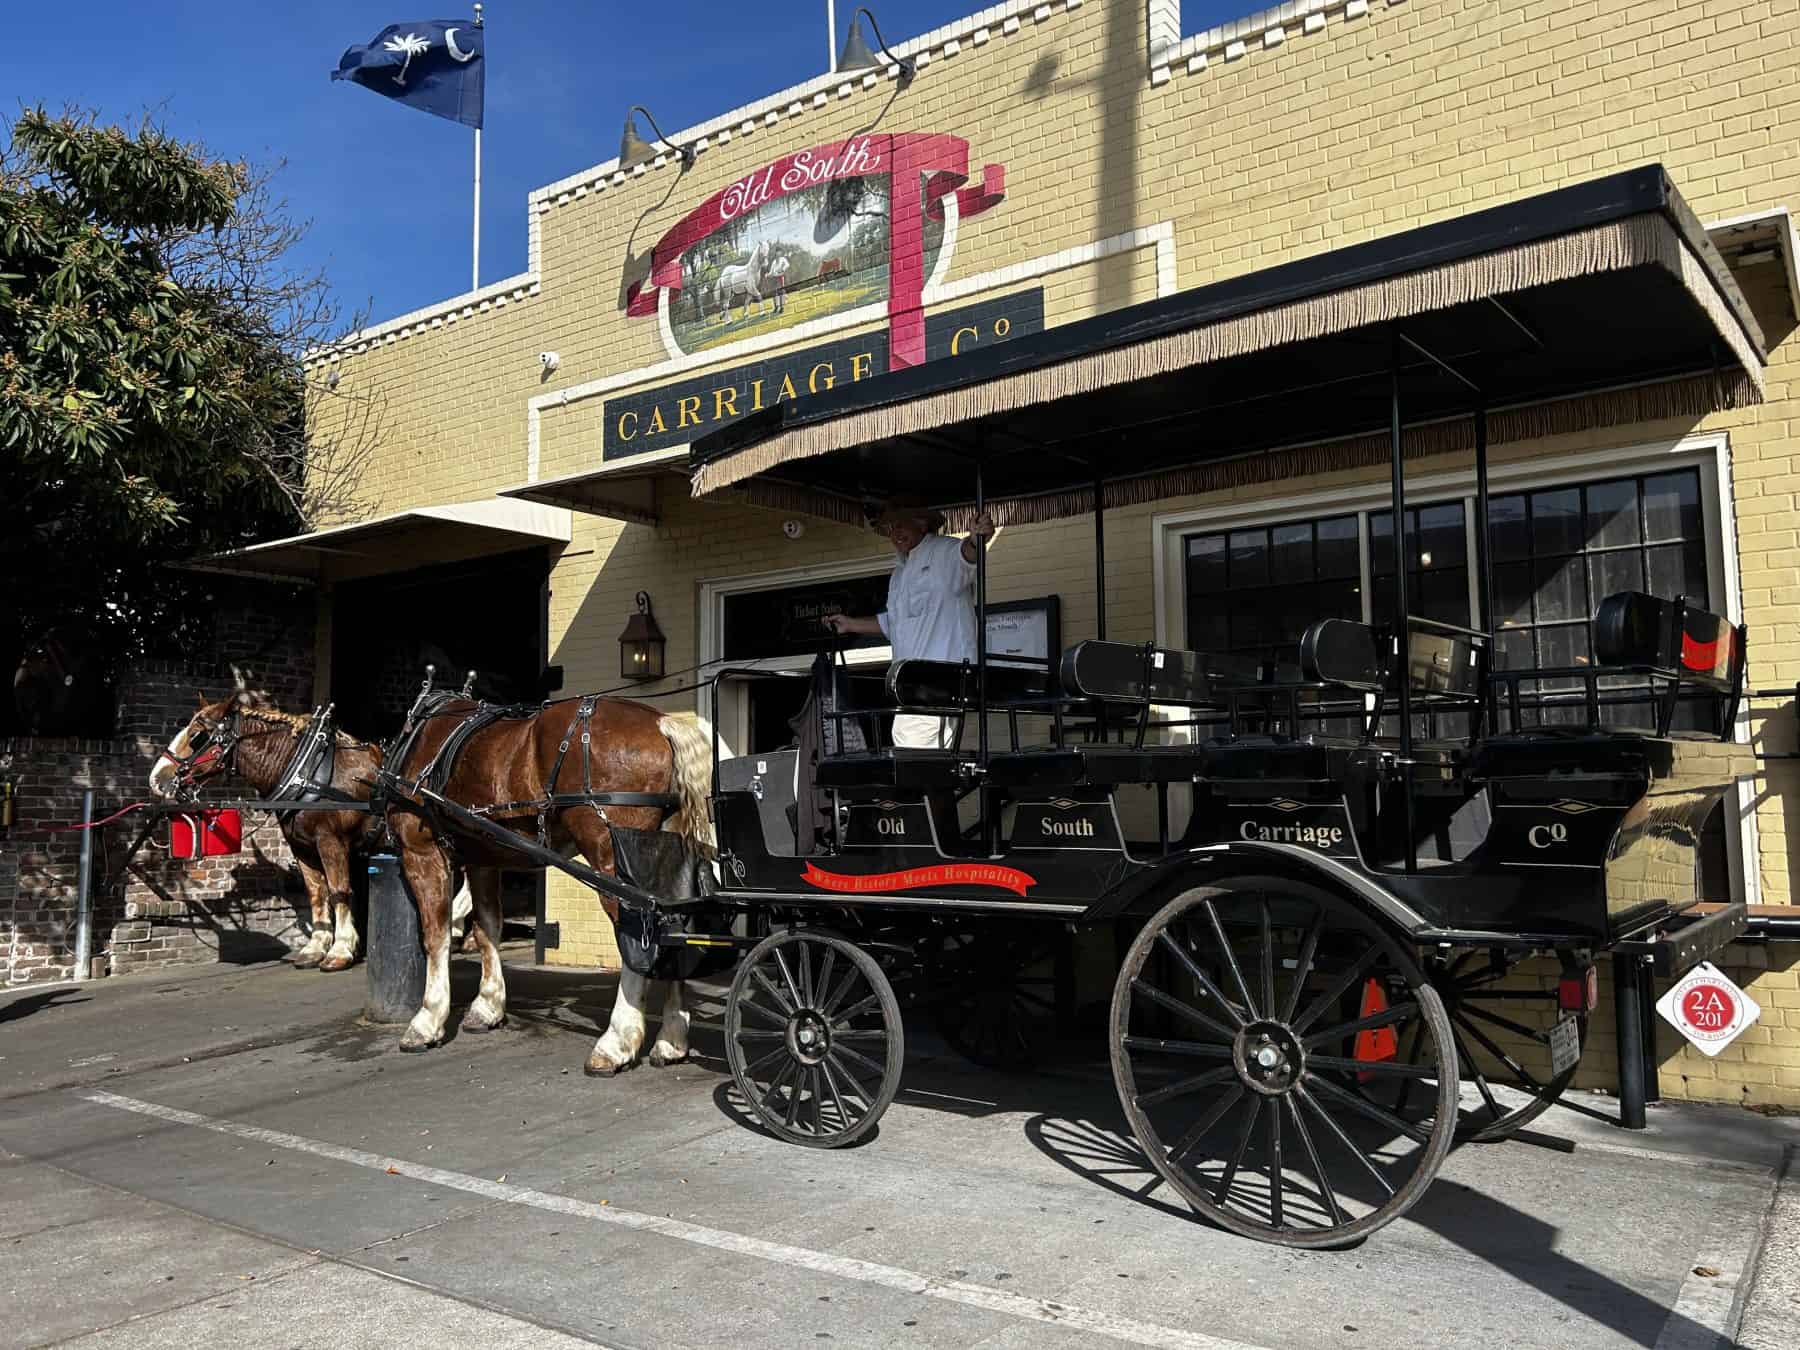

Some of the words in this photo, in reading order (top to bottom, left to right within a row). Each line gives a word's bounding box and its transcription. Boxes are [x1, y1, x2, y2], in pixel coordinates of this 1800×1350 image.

[720, 166, 773, 219] Old
[781, 138, 881, 190] South
[618, 352, 873, 441] CARRIAGE
[877, 817, 905, 835] Old
[1041, 817, 1094, 837] South
[1239, 820, 1342, 848] Carriage
[1528, 820, 1568, 849] Co
[943, 866, 1020, 888] Hospitality
[1690, 991, 1725, 1011] 2A
[1695, 1011, 1722, 1028] 201
